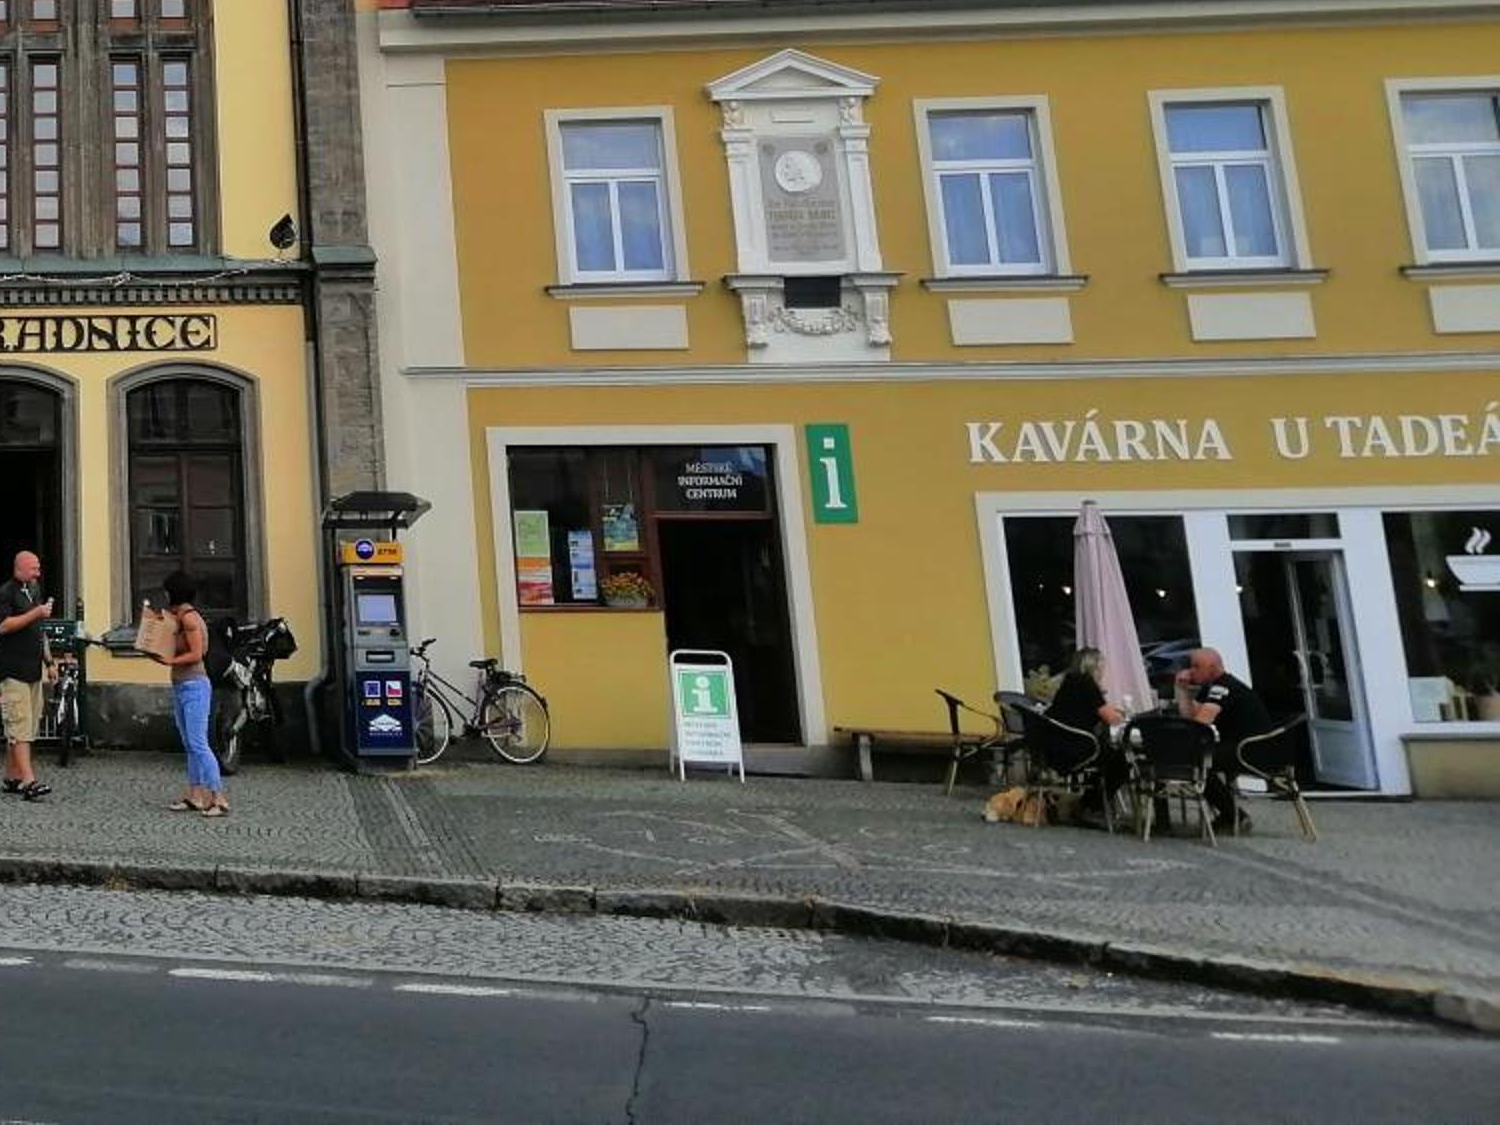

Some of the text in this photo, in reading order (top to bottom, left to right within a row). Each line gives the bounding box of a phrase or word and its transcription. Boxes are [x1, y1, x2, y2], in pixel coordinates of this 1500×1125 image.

[965, 401, 1500, 463] KAVÁRNA U TADEÁ
[685, 488, 738, 500] CENTRUM
